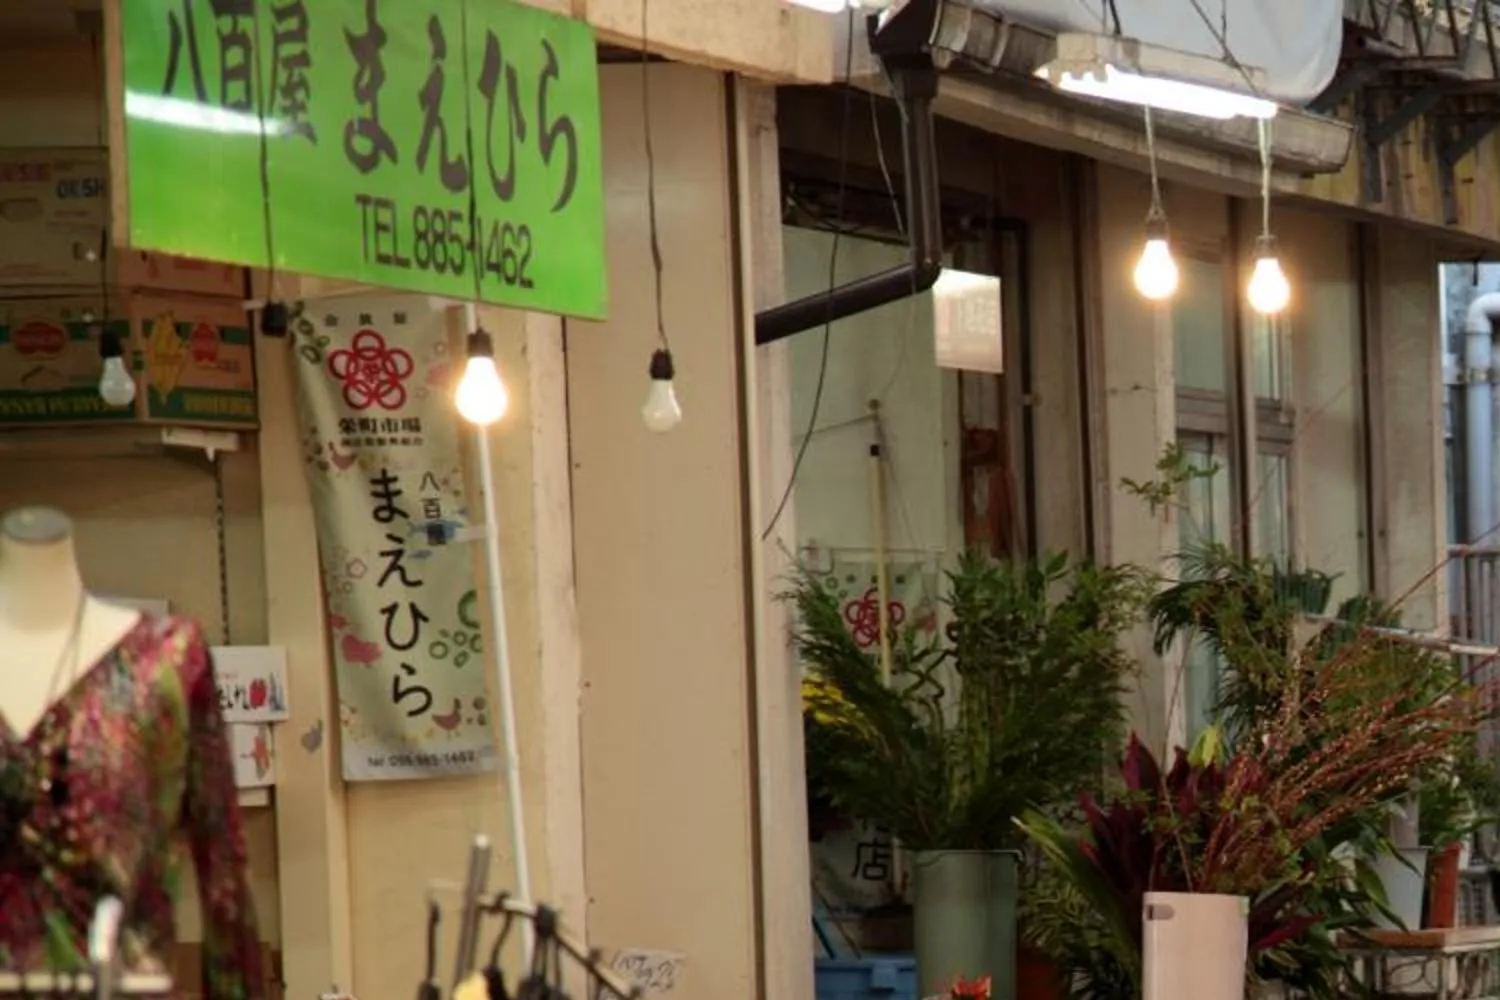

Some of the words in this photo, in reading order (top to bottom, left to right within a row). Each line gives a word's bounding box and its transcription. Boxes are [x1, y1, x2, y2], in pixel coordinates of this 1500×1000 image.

[343, 0, 578, 214] まえひら
[355, 193, 411, 269] TEL
[368, 467, 434, 718] まえひら
